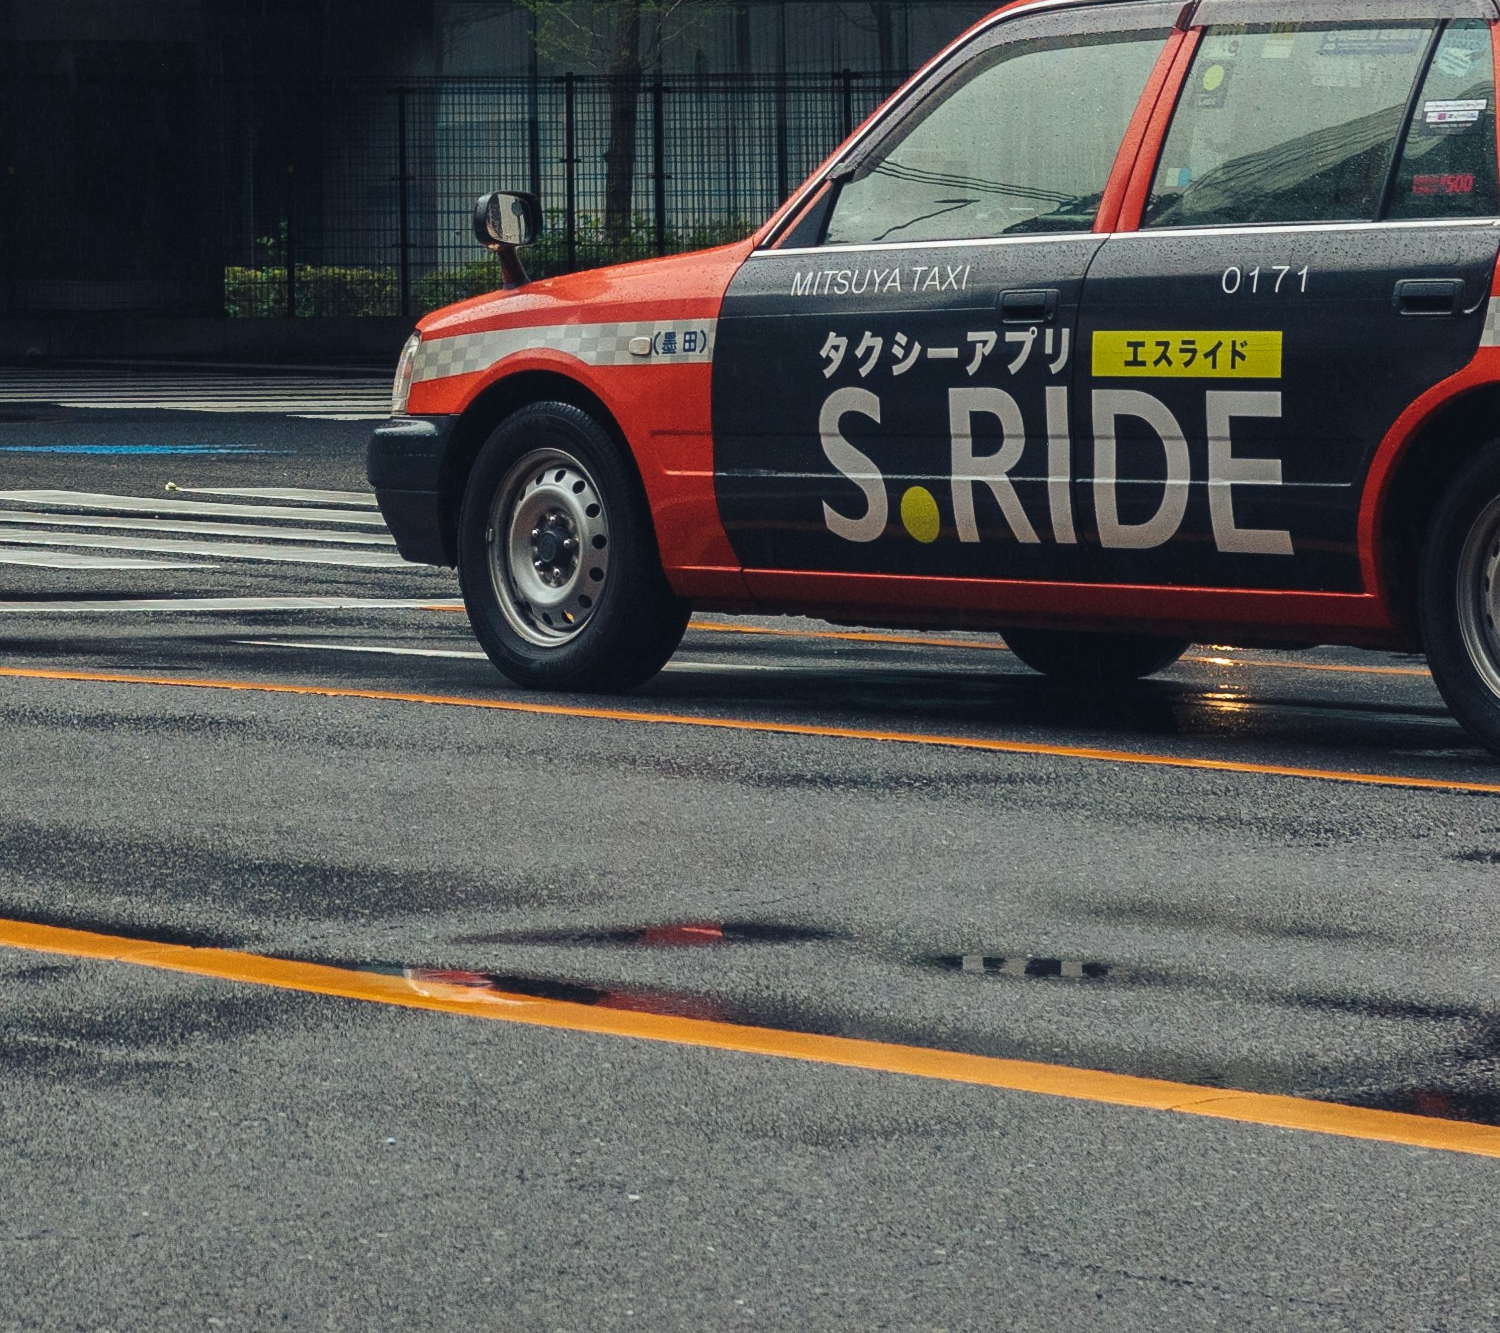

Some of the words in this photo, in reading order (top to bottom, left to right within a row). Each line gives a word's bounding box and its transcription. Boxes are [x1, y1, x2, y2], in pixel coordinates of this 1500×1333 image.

[790, 270, 902, 297] MITSUYA
[911, 265, 971, 292] TAXI
[1221, 265, 1310, 294] 0171
[819, 327, 1070, 379] タクシーアプリ
[1123, 339, 1250, 371] エスライド
[818, 385, 1295, 555] S.RIDE
